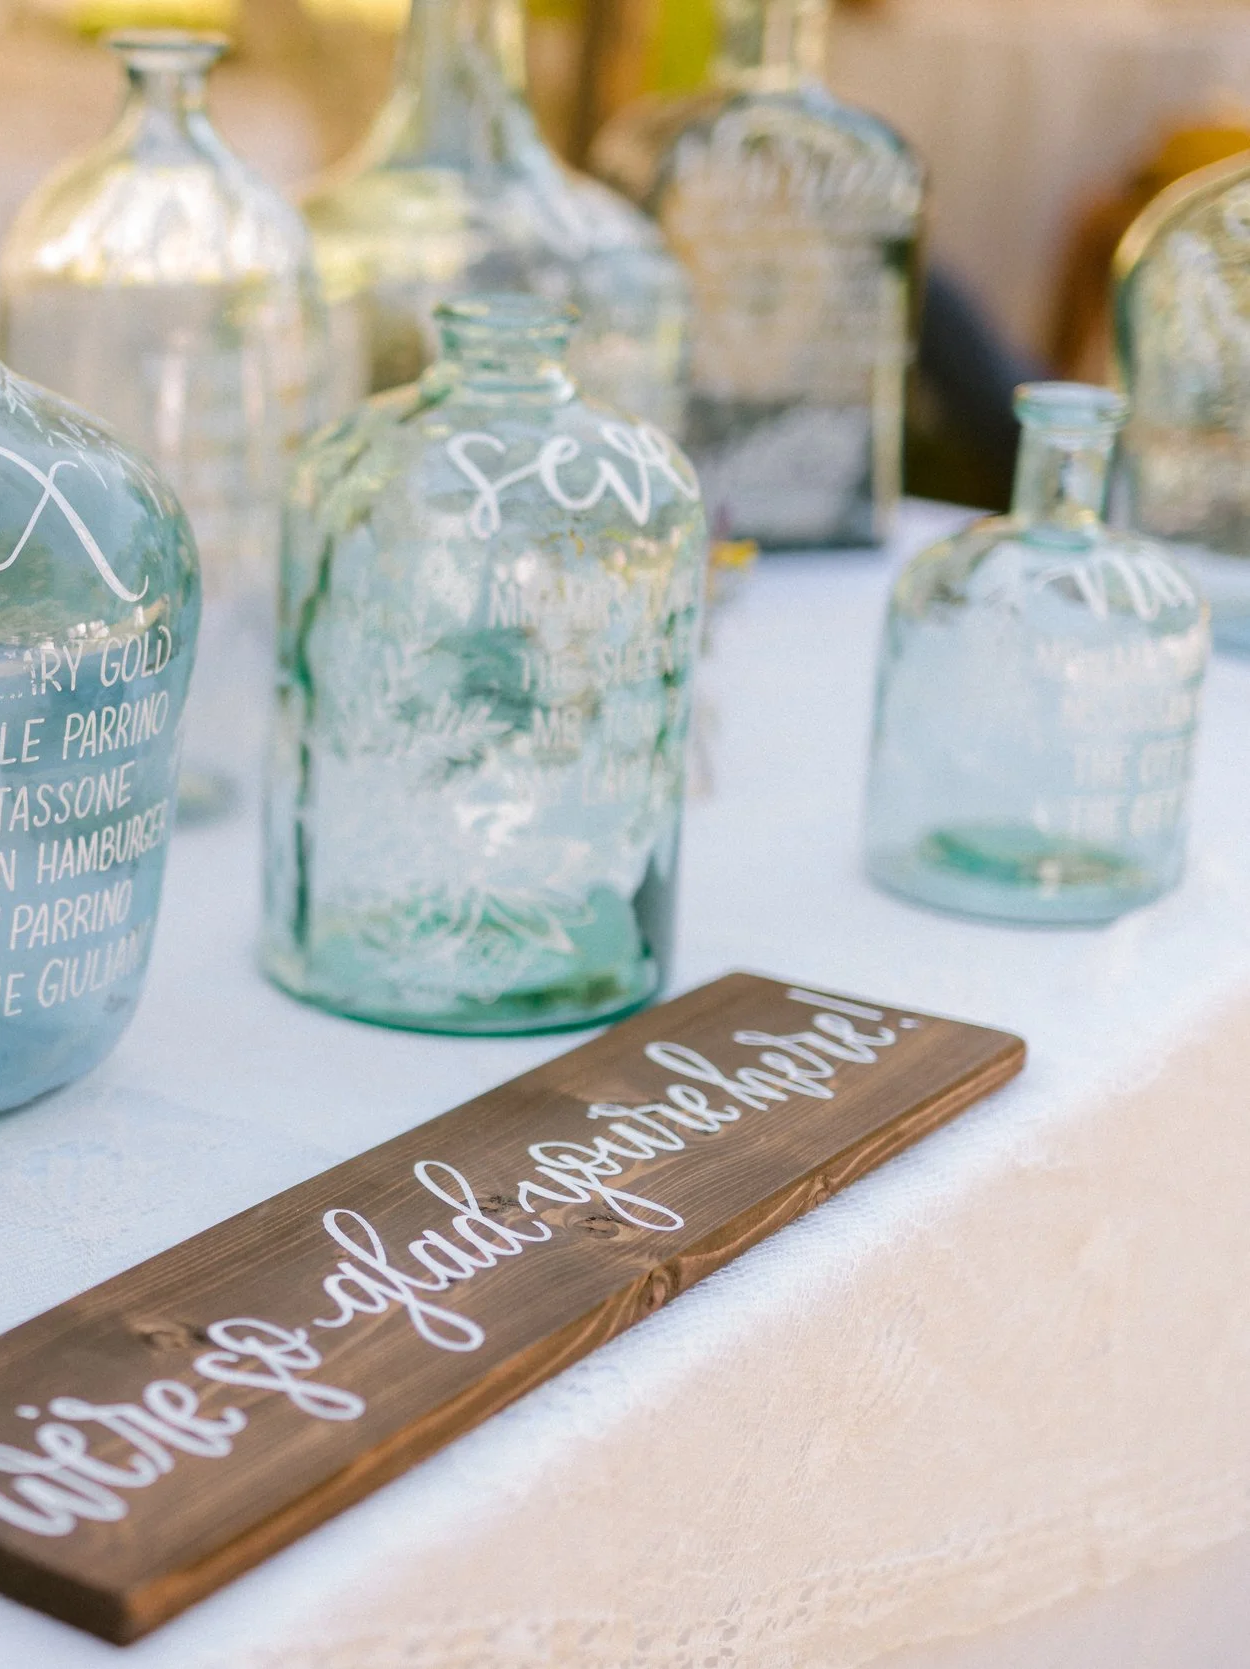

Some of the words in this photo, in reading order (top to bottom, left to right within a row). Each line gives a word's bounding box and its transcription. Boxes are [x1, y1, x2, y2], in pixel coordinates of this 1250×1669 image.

[447, 422, 701, 539] seve
[100, 624, 172, 687] GOLD
[62, 690, 168, 761] PARRINO
[9, 879, 133, 952] PARRINO
[192, 1316, 366, 1421] so
[312, 1160, 553, 1353] glad
